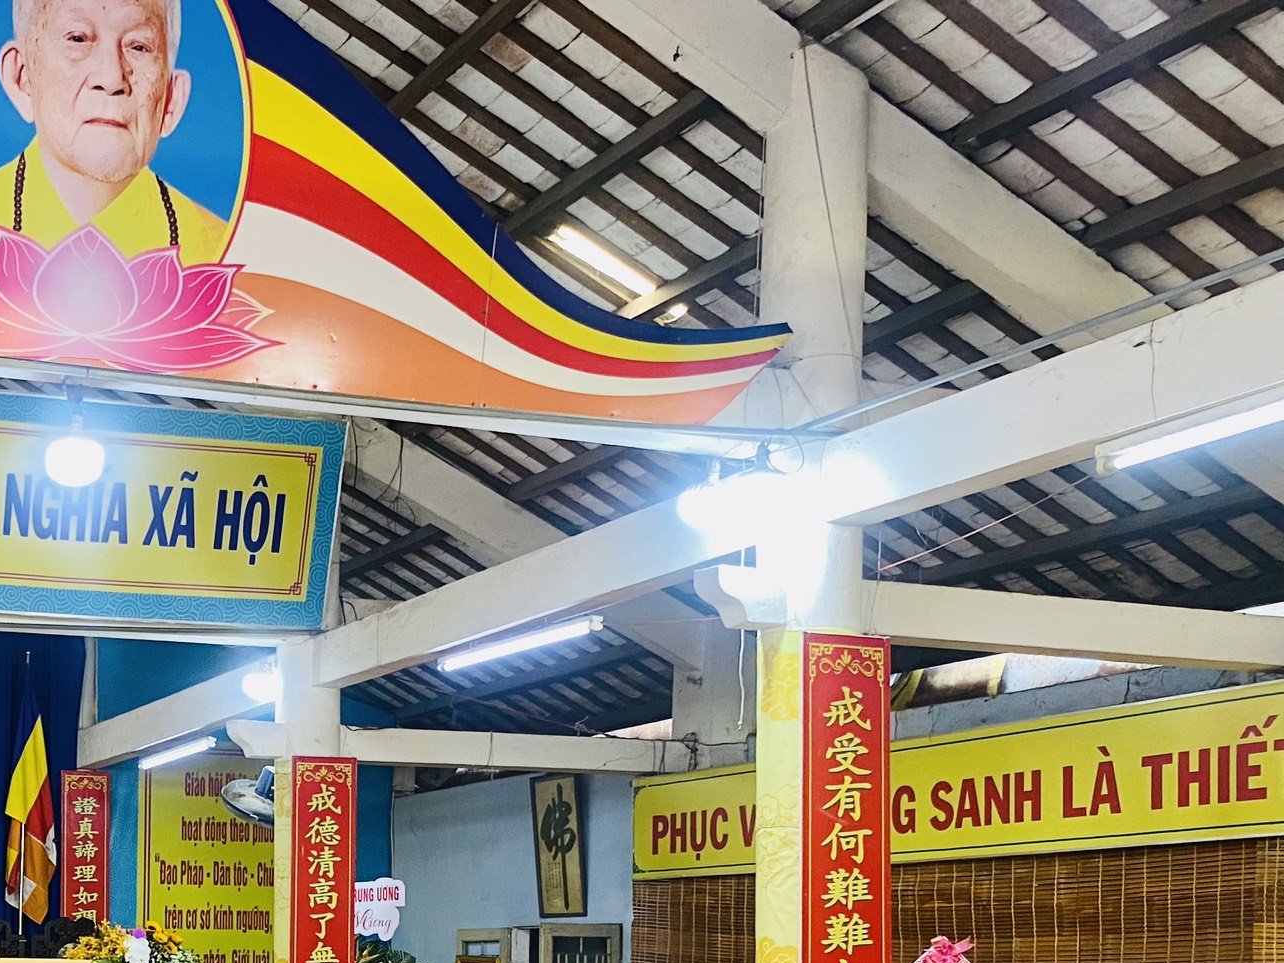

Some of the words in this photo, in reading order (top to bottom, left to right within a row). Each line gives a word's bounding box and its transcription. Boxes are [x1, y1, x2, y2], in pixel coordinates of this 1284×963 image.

[142, 470, 197, 549] XÃ
[212, 474, 287, 566] HỘI
[185, 772, 206, 797] Giáo
[929, 769, 1042, 831] SANH
[1062, 745, 1122, 819] LÀ
[1141, 715, 1284, 811] THIẾ
[181, 816, 202, 847] hoạt
[205, 816, 227, 848] động
[230, 817, 250, 842] theo
[652, 807, 728, 861] PHỤC
[180, 860, 204, 888] Pháp
[213, 860, 231, 886] Dân
[233, 861, 248, 892] tộc
[164, 904, 183, 930] trên
[186, 908, 198, 930] cơ
[200, 902, 211, 930] sở
[213, 905, 234, 930] kính
